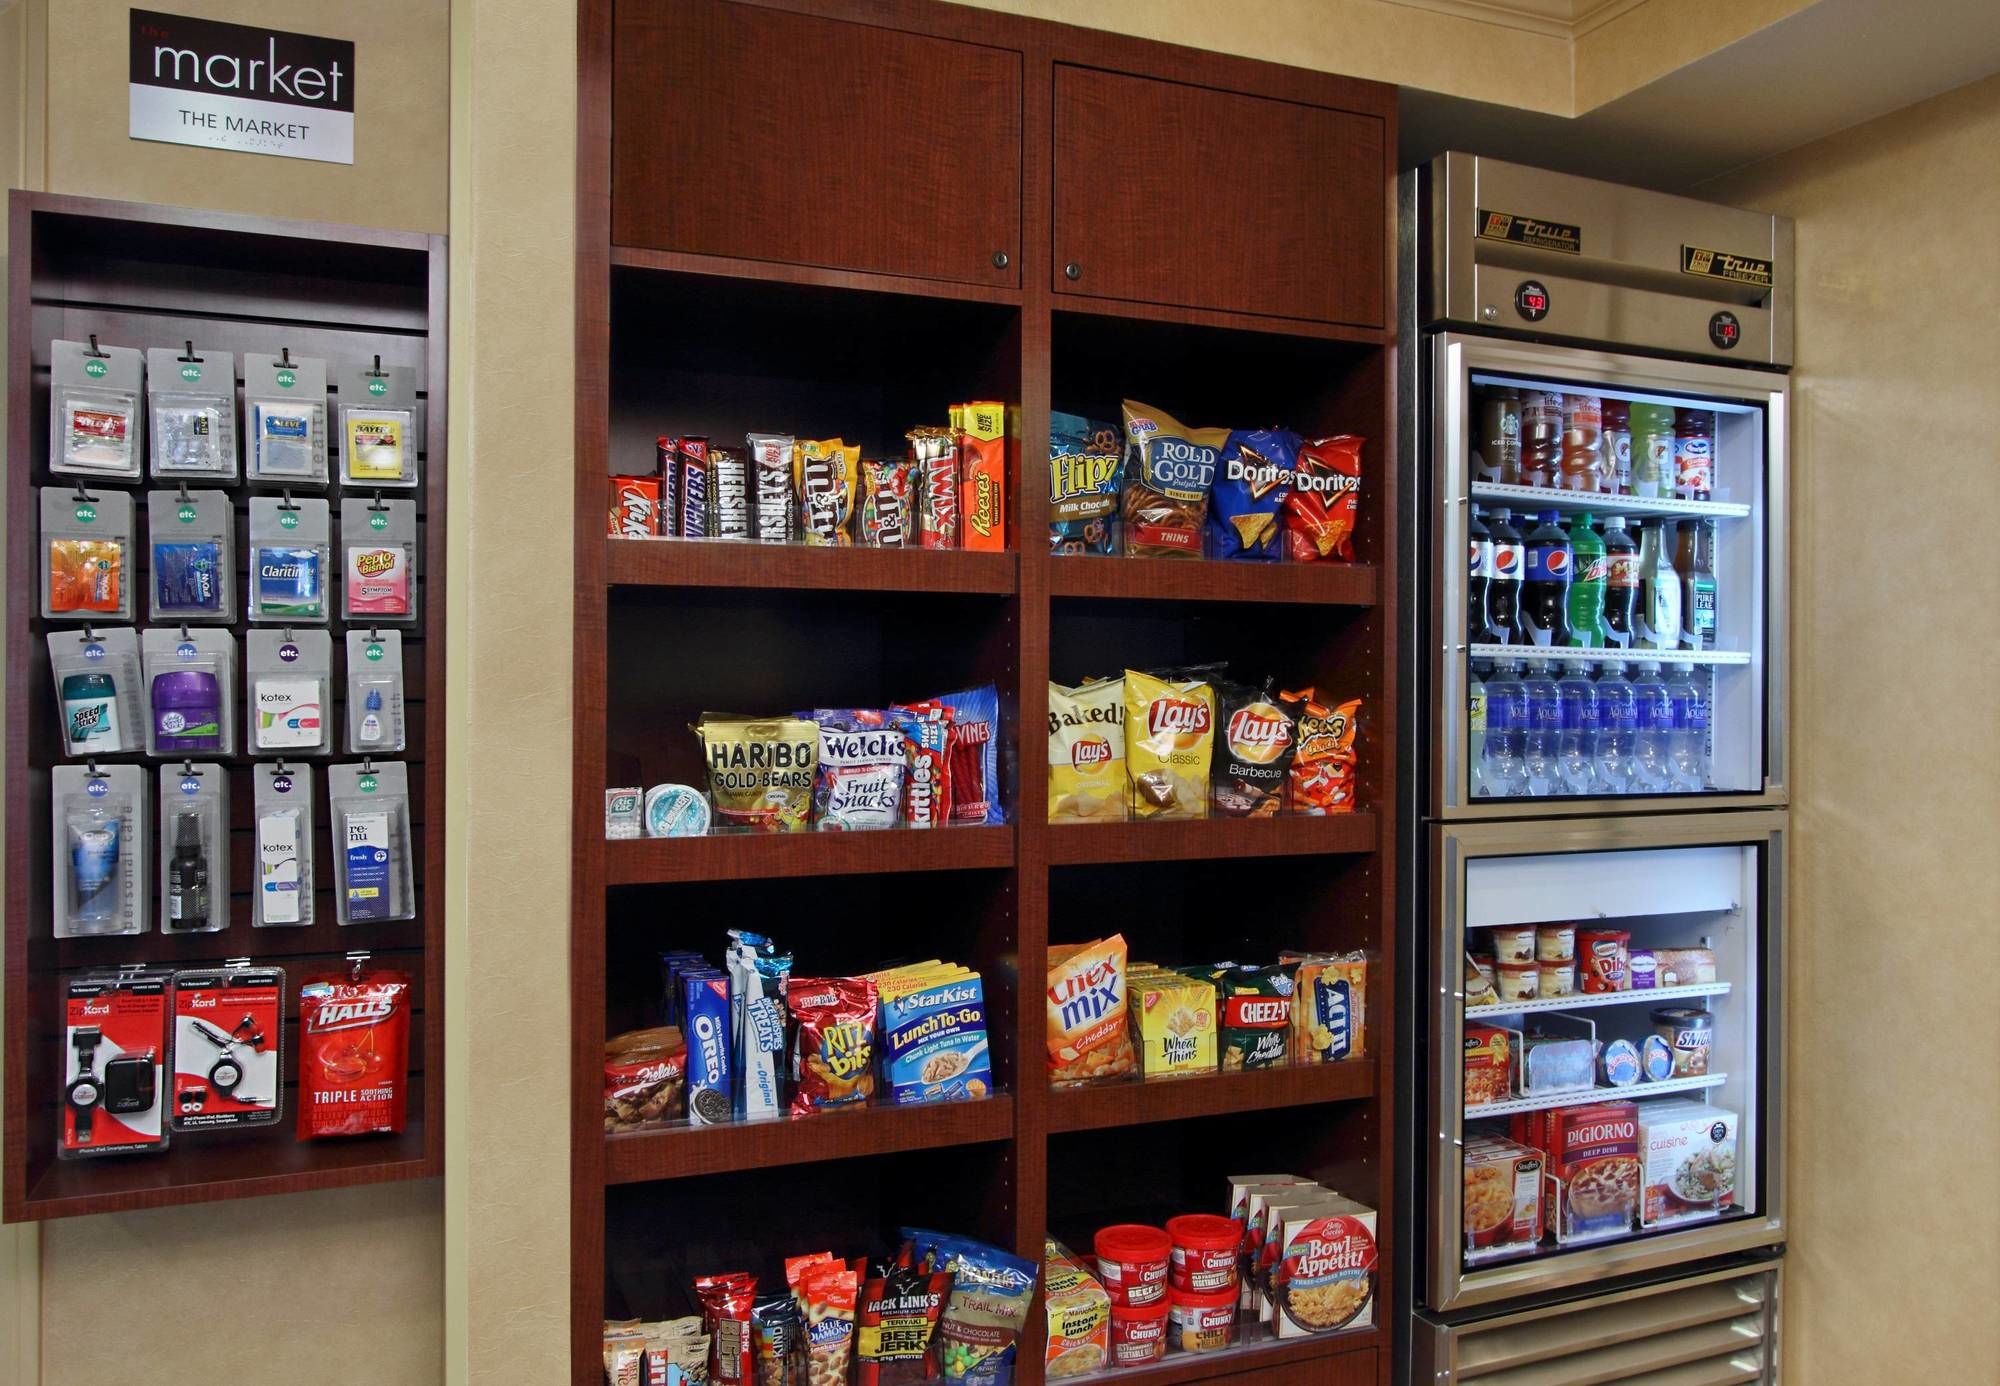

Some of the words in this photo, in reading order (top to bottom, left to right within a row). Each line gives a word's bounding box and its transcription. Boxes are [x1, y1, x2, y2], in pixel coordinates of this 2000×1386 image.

[154, 37, 344, 102] market
[179, 110, 217, 129] THE
[226, 116, 310, 140] MARKET
[1523, 236, 1575, 251] REFRIGERATOR
[1723, 270, 1768, 283] FREEZER
[1529, 297, 1543, 309] 43
[87, 365, 107, 373] etc.
[182, 368, 201, 376] etc.
[984, 414, 992, 432] SIZE
[1162, 442, 1215, 464] ROLD
[1050, 454, 1119, 501] Flipz
[1154, 460, 1215, 486] GOLD
[1228, 460, 1296, 485] Doritos
[928, 451, 958, 528] TWIX
[760, 470, 790, 544] ERSHEY'S
[970, 472, 993, 538] Reese's
[1060, 504, 1078, 513] Milk
[76, 510, 96, 518] etc.
[178, 510, 196, 518] etc.
[1161, 532, 1190, 544] THINS
[356, 550, 396, 566] Pepto-
[262, 565, 304, 578] Claritin
[358, 560, 394, 575] Bismol
[202, 573, 212, 598] NyQuil
[1696, 592, 1714, 600] PURE
[1696, 601, 1714, 610] LEAF
[86, 650, 105, 658] etc.
[178, 648, 198, 656] etc.
[366, 648, 384, 656] etc.
[260, 692, 292, 702] kotex
[74, 705, 100, 723] SPEED
[1048, 702, 1124, 736] Baked!
[1152, 699, 1208, 733] Lay's
[78, 716, 97, 729] STICK
[1234, 712, 1294, 746] Lay's
[930, 724, 938, 744] SIZE
[957, 722, 990, 744] VINES
[822, 734, 906, 758] Welch's
[1074, 738, 1110, 766] Lay's
[711, 742, 812, 769] HARIBO
[1158, 752, 1200, 766] Classic
[1228, 764, 1282, 778] Barbecue
[88, 784, 109, 792] etc.
[181, 782, 200, 790] etc.
[274, 781, 292, 789] etc.
[360, 780, 378, 788] etc.
[714, 772, 812, 789] GOLD-BEARS
[847, 778, 890, 794] Fruit
[910, 754, 933, 829] kittles
[614, 803, 631, 811] tac
[832, 791, 895, 811] Snacks
[350, 832, 368, 841] nu
[263, 842, 293, 853] kotex
[1600, 957, 1626, 974] Dibs
[887, 984, 901, 992] 230
[902, 982, 928, 991] Calories
[801, 998, 816, 1009] BIG
[816, 993, 838, 1006] BAG
[908, 986, 976, 1009] StarKist
[1062, 975, 1120, 1031] mix
[318, 996, 393, 1026] HALLS
[1326, 988, 1347, 1038] ACT
[748, 1001, 774, 1053] TREATS
[769, 1012, 784, 1050] KRISPIES
[892, 1016, 938, 1050] Lunch
[930, 1031, 944, 1040] YOUR
[946, 1026, 960, 1036] OWN
[824, 1022, 866, 1056] RITZ
[1076, 1021, 1118, 1050] Cheddar
[1257, 1032, 1281, 1050] White
[694, 1015, 720, 1084] OREO
[905, 1050, 924, 1064] Chunk
[924, 1043, 940, 1055] Light
[940, 1040, 954, 1049] Tuna
[962, 1034, 980, 1044] Water
[1164, 1035, 1198, 1053] Wheat
[828, 1044, 872, 1077] bits
[1162, 1050, 1198, 1065] Thins
[1246, 1044, 1285, 1064] Cheddar
[638, 1064, 679, 1080] Fields
[360, 1087, 392, 1096] SOOTHING
[758, 1070, 774, 1106] Original
[314, 1090, 357, 1104] TRIPLE
[360, 1092, 392, 1102] ACTION
[1650, 1135, 1688, 1150] cuisine
[1583, 1148, 1600, 1158] DEEP
[1602, 1146, 1618, 1156] DISH
[1310, 1236, 1350, 1260] Bowl
[1206, 1256, 1235, 1268] CHUNKY
[1296, 1251, 1364, 1278] Appétit!
[1144, 1266, 1168, 1282] CHUNKY
[1340, 1269, 1361, 1278] ROTINI
[1128, 1286, 1156, 1298] BEEF
[868, 1298, 896, 1312] JACK
[900, 1292, 941, 1310] LINK'S
[962, 1296, 993, 1312] TRAIL
[993, 1305, 1017, 1318] MIX
[818, 1319, 841, 1333] BLUE
[1062, 1314, 1099, 1330] Instant
[1202, 1316, 1232, 1327] CHUNKY
[811, 1322, 853, 1342] DIAMOND
[880, 1330, 928, 1342] BEEF
[962, 1328, 1000, 1338] CHOCOLATE
[1065, 1324, 1094, 1337] Lunch
[1130, 1328, 1161, 1340] CHUNKY
[1196, 1330, 1224, 1340] CHILI
[772, 1326, 784, 1358] KIND
[874, 1340, 930, 1354] JERKY
[629, 1352, 639, 1380] FIBER
